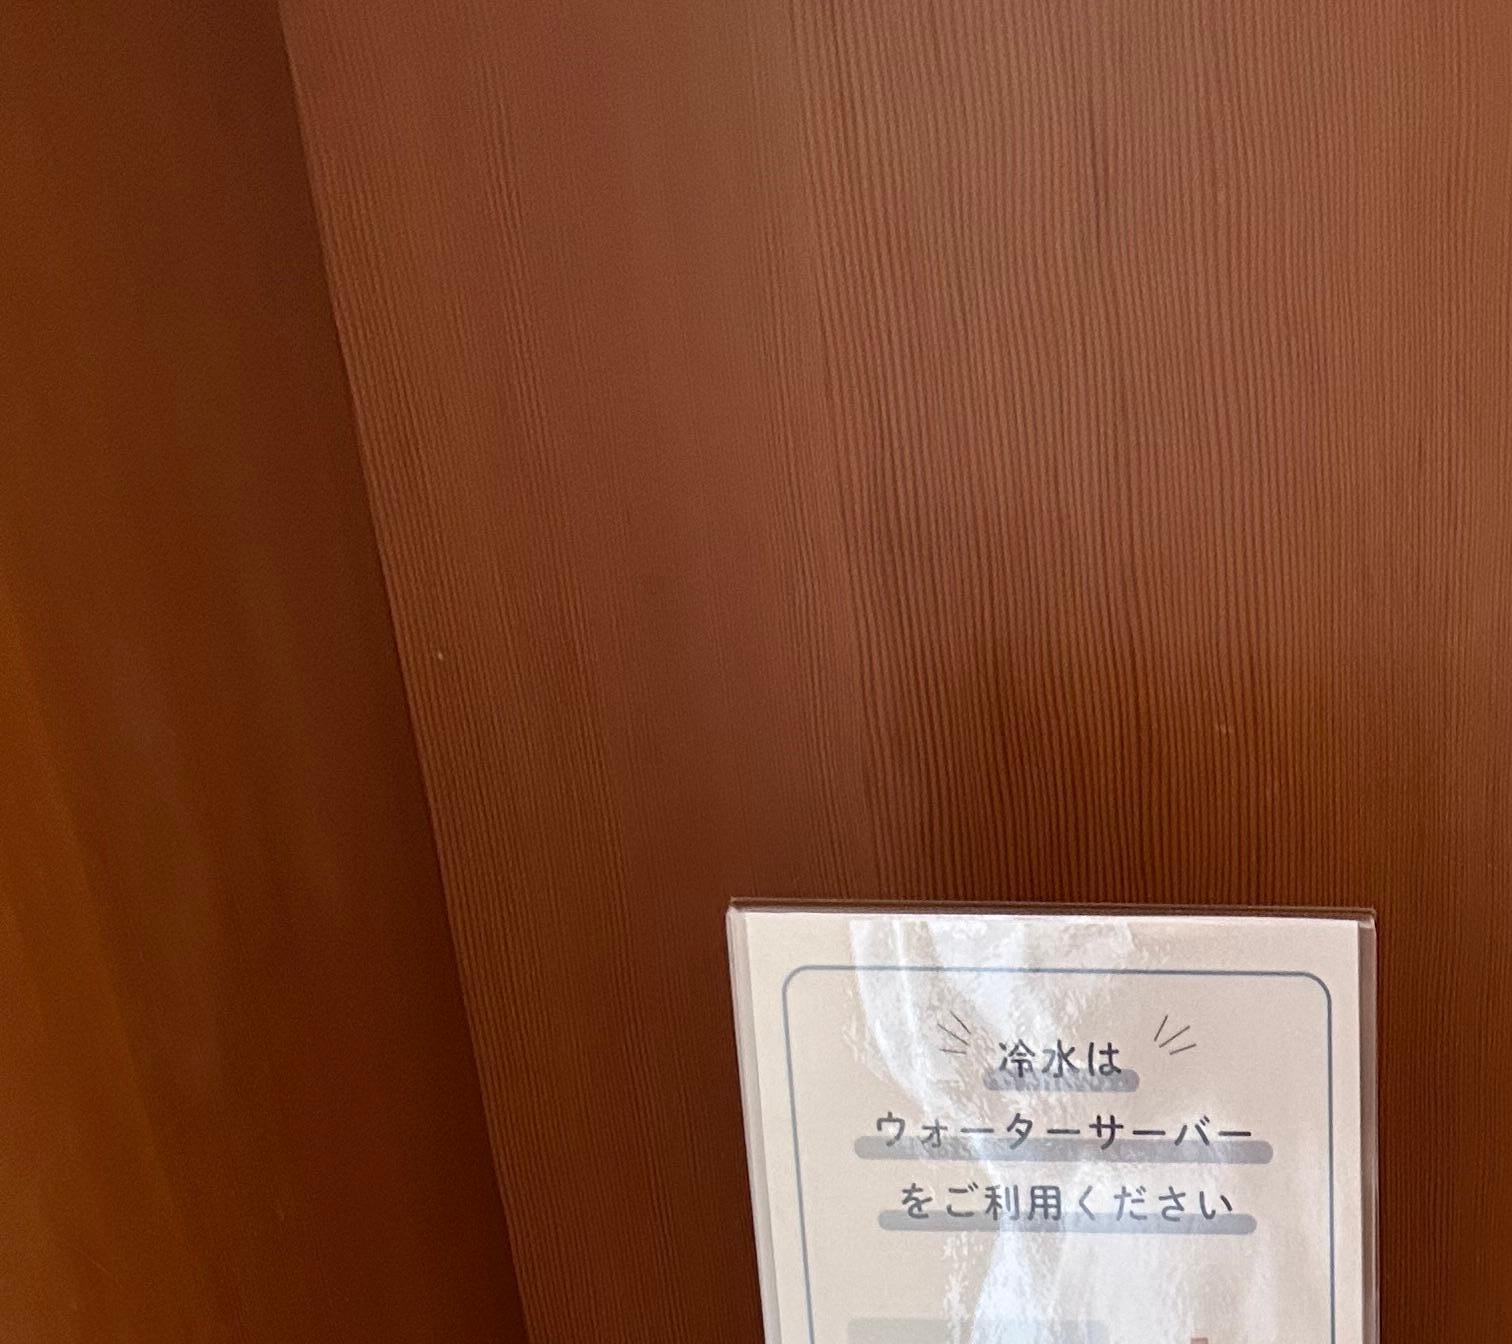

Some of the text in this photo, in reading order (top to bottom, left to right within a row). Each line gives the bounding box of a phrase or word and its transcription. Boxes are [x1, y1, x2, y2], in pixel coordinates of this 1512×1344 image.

[998, 1040, 1122, 1079] 冷水は
[875, 1112, 1253, 1150] ウォーターサーバー
[900, 1183, 1234, 1222] をご利用ください
